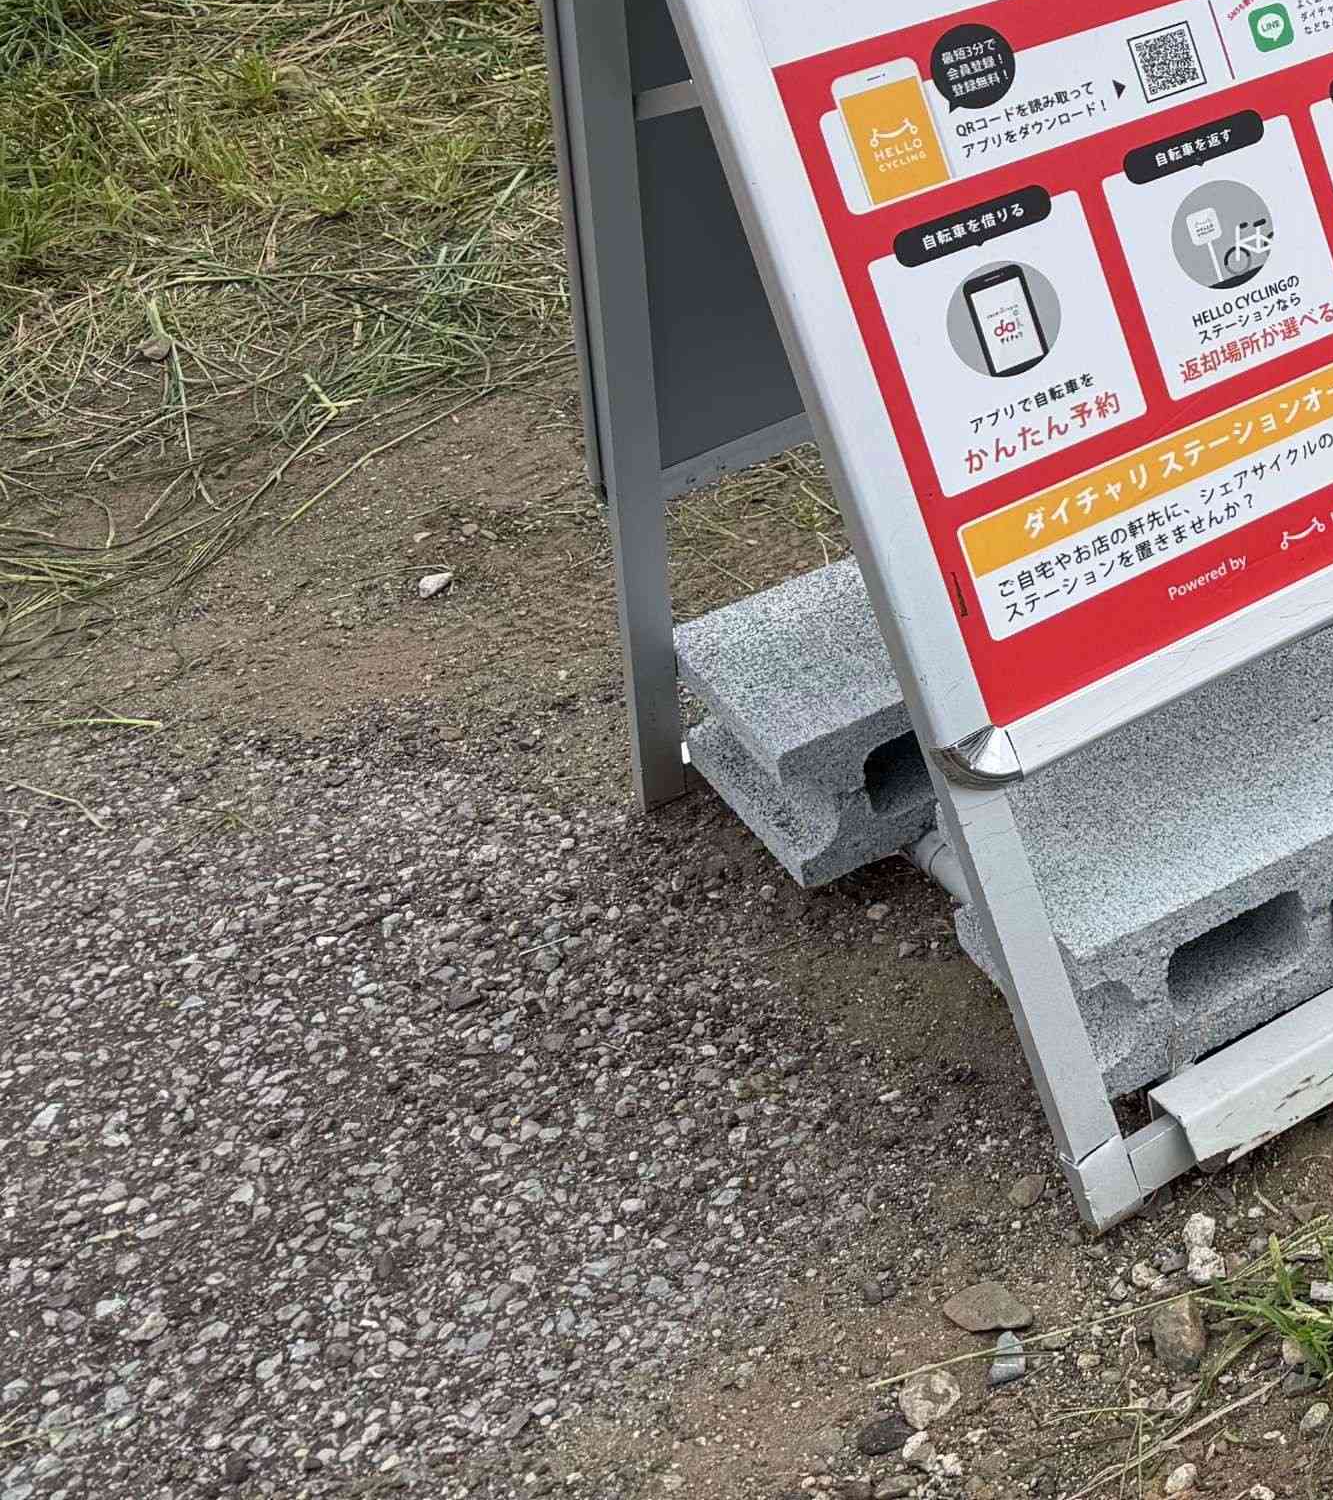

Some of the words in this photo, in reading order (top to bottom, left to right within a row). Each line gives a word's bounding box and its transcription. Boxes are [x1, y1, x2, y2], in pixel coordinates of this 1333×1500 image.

[940, 37, 996, 64] 最短3分で
[1261, 19, 1280, 33] LINE
[955, 81, 1095, 139] QRコードを読み取って
[873, 137, 923, 162] HELLO
[878, 150, 928, 173] CYCLING
[1154, 128, 1233, 167] 自転車を返す
[922, 203, 1026, 251] 自転車を借りる
[1191, 302, 1234, 328] HELLO
[1234, 274, 1300, 311] CYCLINGの
[1198, 292, 1301, 345] ステーションなら
[969, 372, 1095, 434] アプリで自転車を
[964, 390, 1121, 475] かんたん予約
[1023, 466, 1149, 539] ダイチャリ
[1005, 493, 1254, 623] ステーションを置きませんか？
[1168, 558, 1227, 601] Powered
[1229, 554, 1247, 573] by
